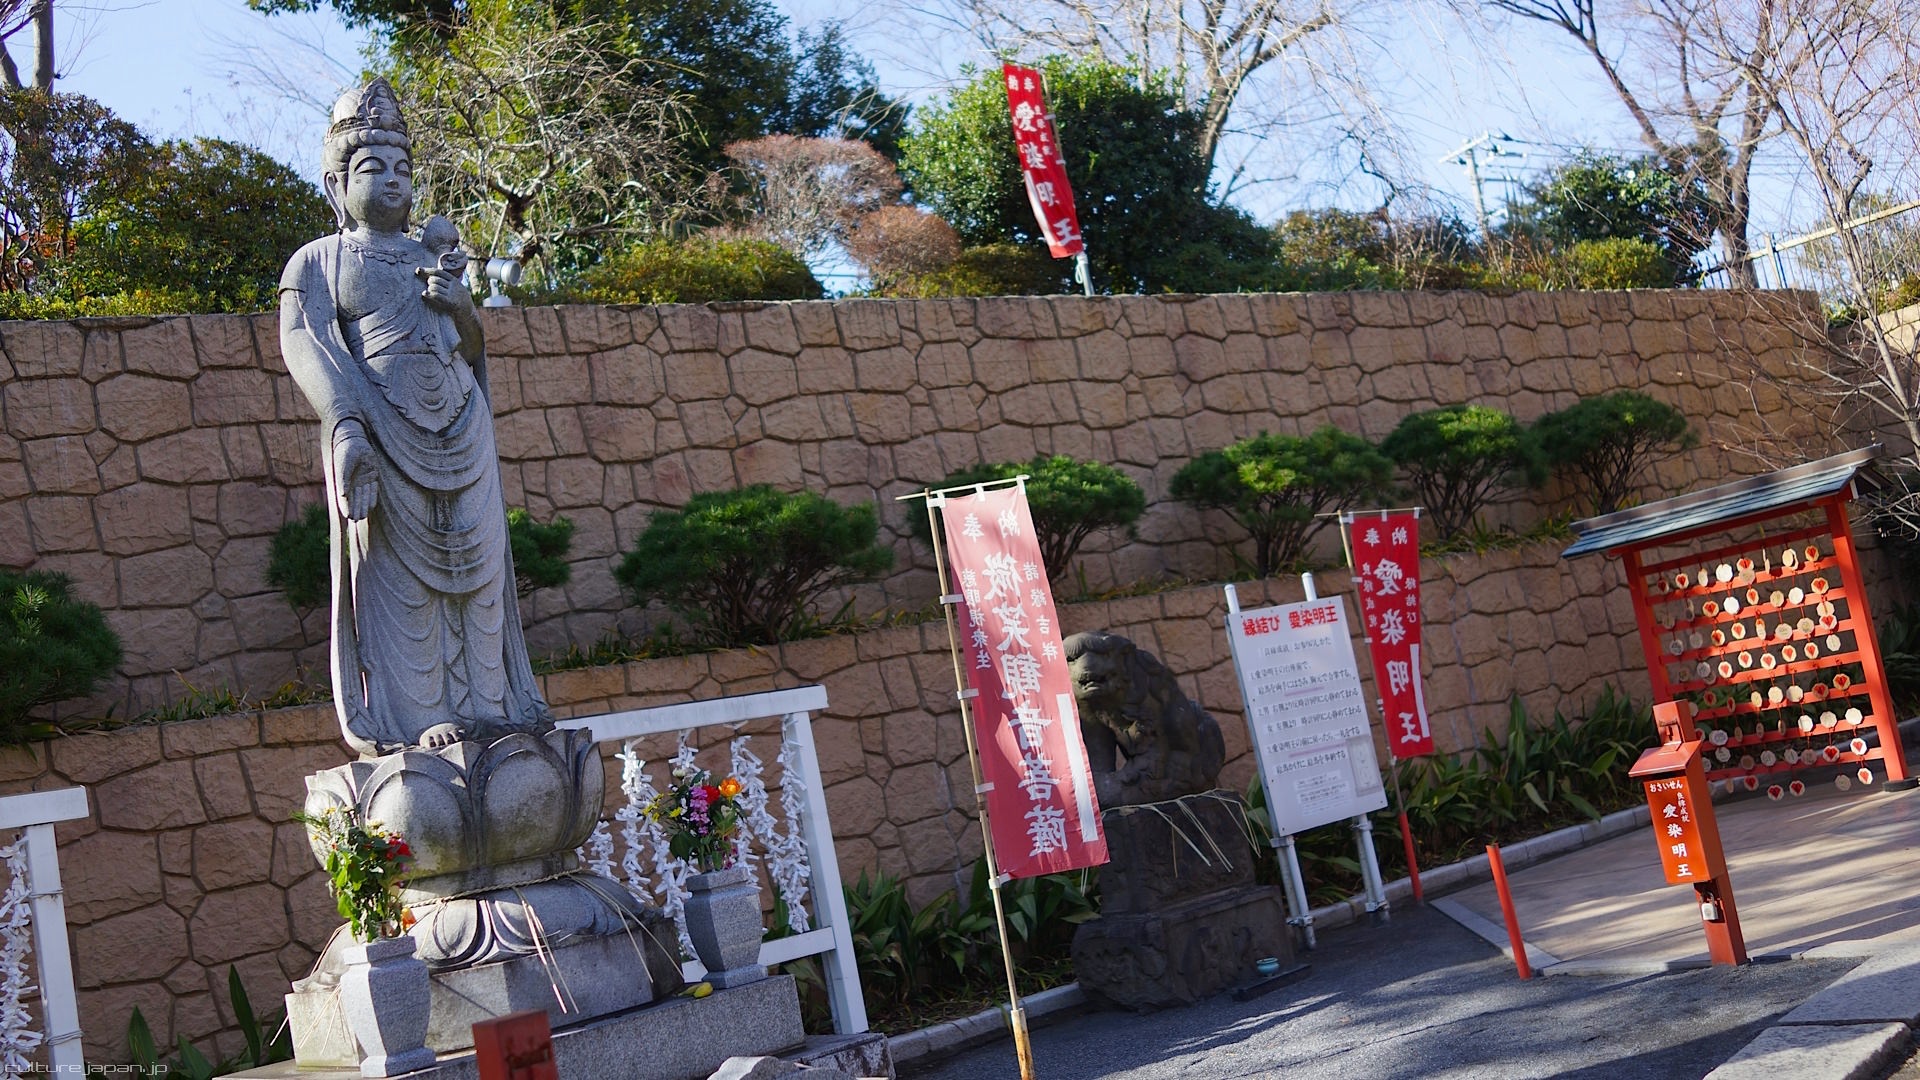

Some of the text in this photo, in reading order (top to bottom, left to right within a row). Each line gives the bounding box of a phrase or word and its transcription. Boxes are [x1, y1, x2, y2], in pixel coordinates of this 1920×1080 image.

[1015, 101, 1081, 247] 愛染明王
[1243, 605, 1338, 637] 縁結び 愛染明王
[1650, 780, 1684, 793] おさいせん
[1663, 804, 1693, 877] 愛染明王
